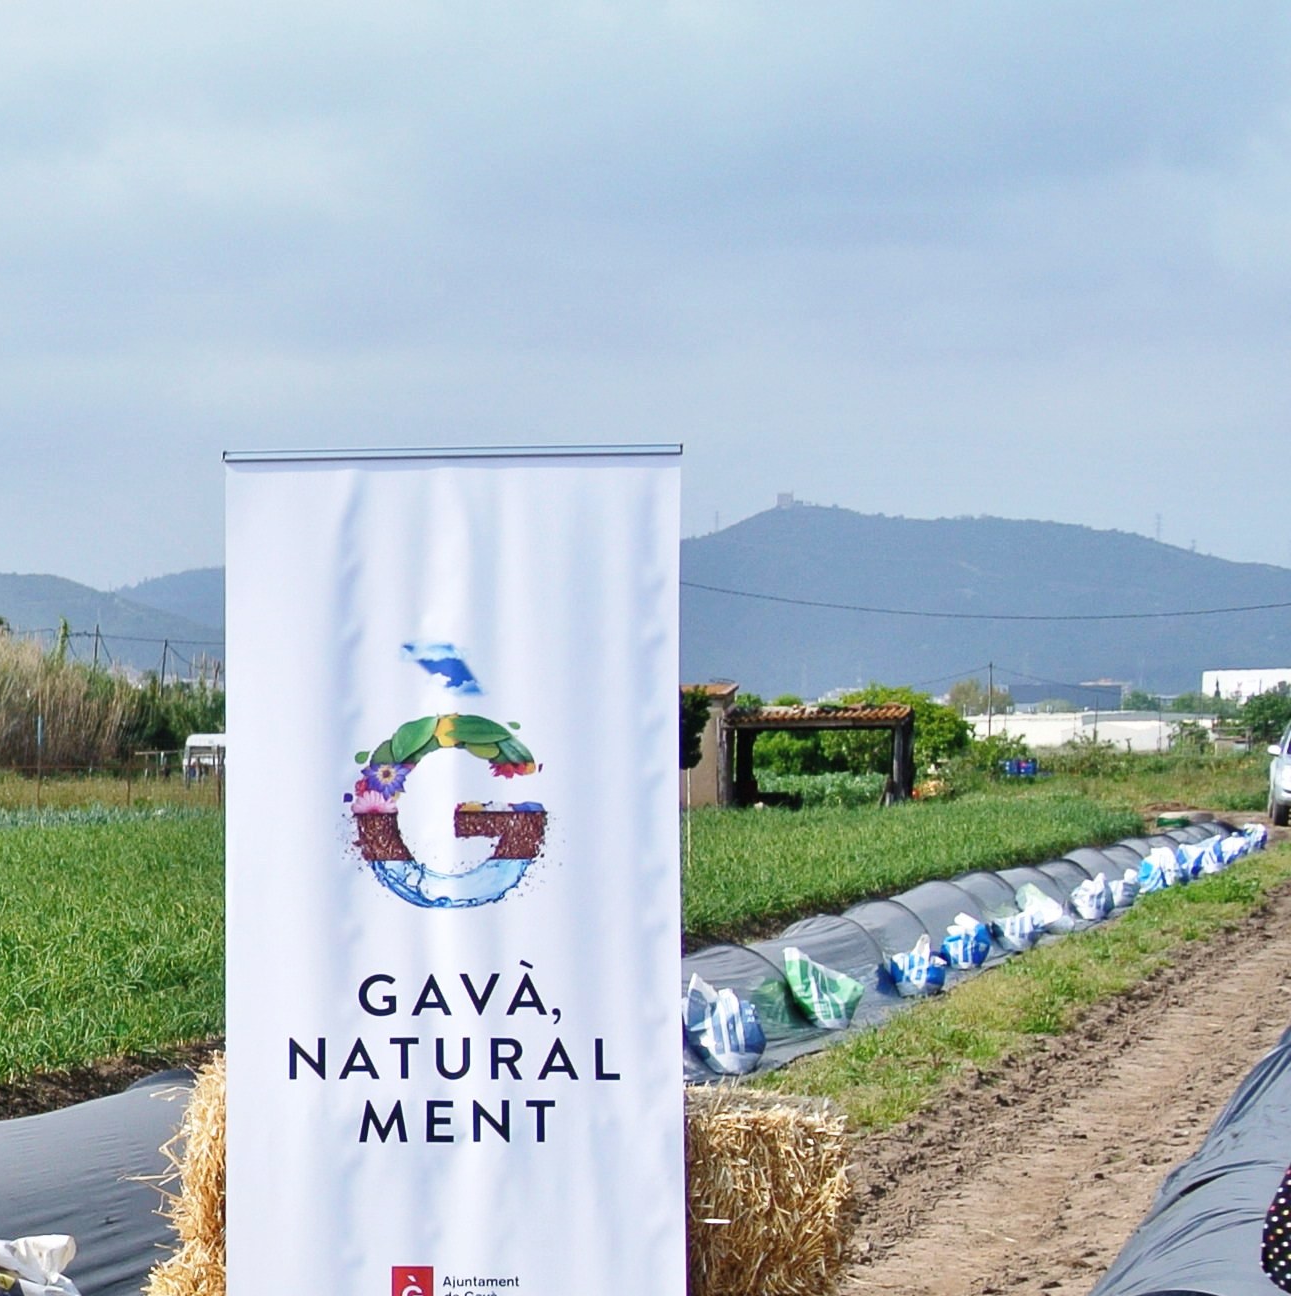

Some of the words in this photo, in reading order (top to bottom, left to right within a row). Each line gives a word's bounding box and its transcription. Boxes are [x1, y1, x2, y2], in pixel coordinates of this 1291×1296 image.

[358, 960, 562, 1024] GAVÀ,
[289, 1037, 620, 1080] NATURAL
[358, 1099, 556, 1143] MENT
[442, 1275, 520, 1289] Ajuntament
